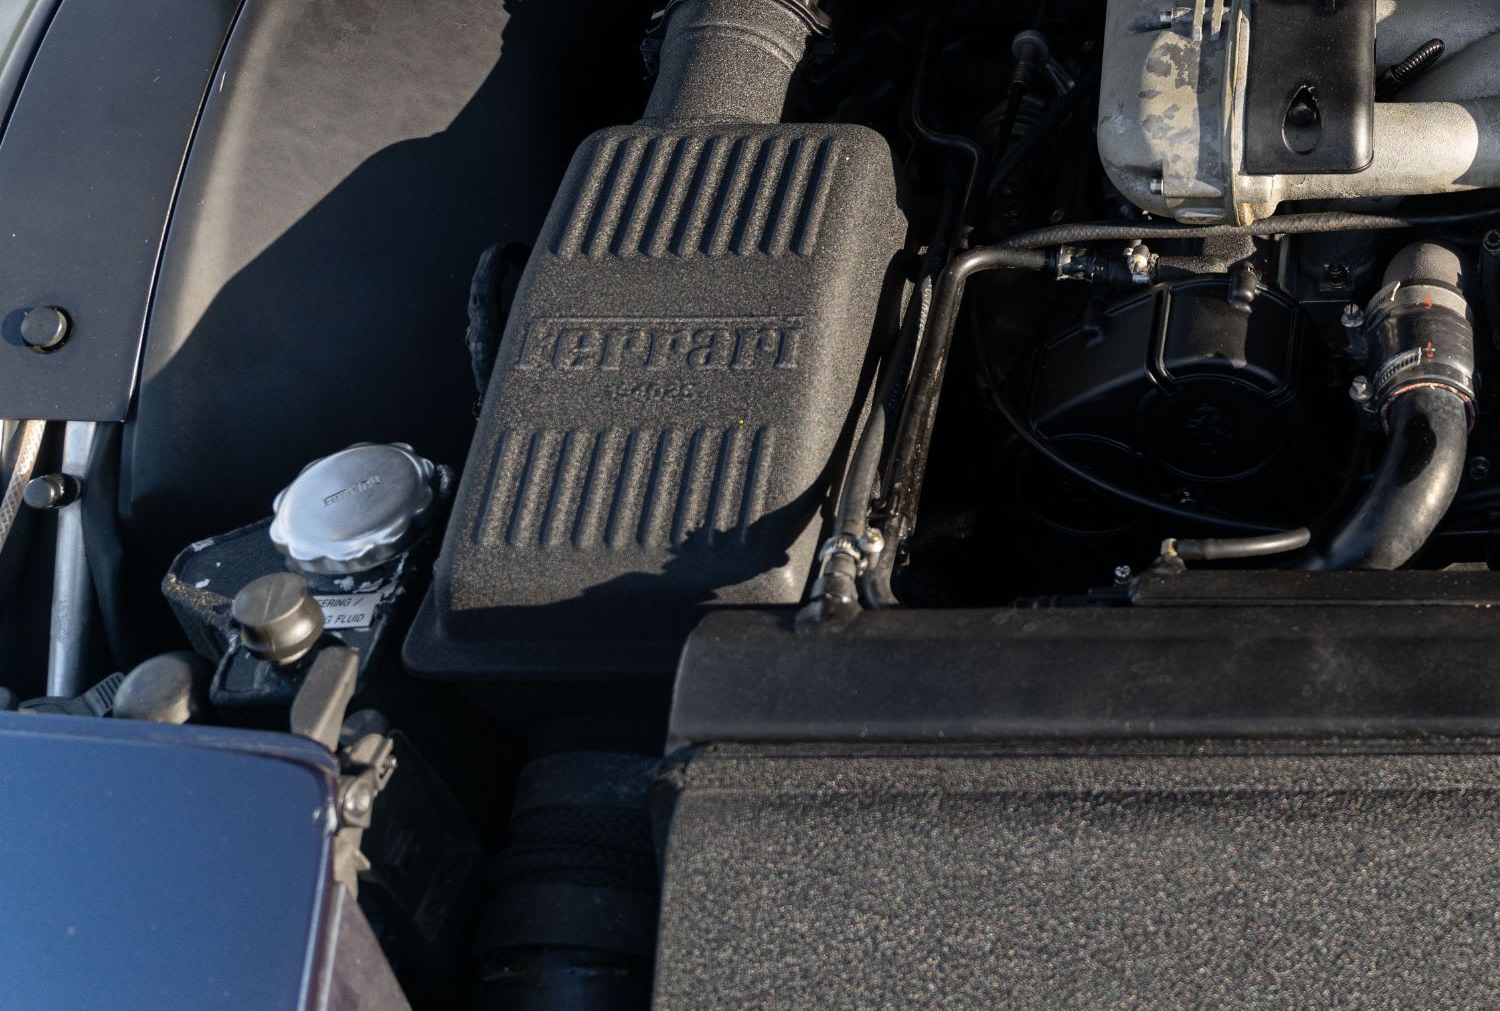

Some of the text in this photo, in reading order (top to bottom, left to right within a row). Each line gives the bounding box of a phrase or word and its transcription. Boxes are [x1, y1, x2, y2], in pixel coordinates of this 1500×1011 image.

[514, 314, 806, 371] Ferrari
[319, 597, 352, 608] ERING
[335, 613, 365, 624] FLUID
